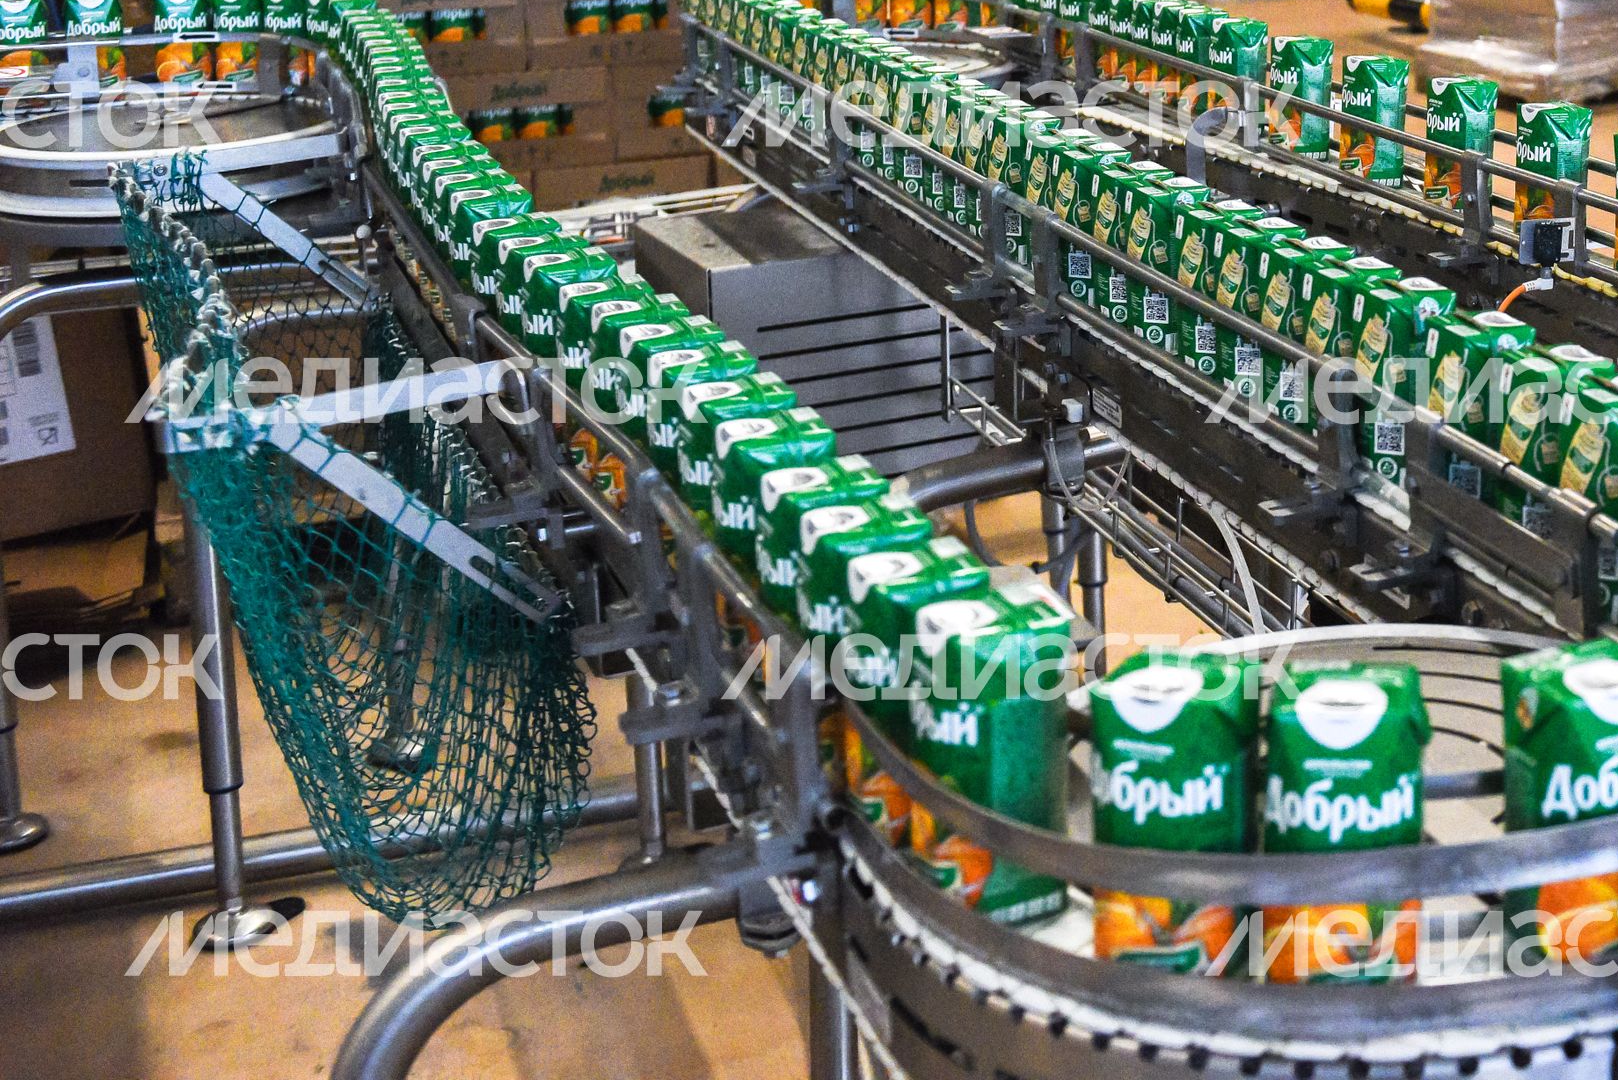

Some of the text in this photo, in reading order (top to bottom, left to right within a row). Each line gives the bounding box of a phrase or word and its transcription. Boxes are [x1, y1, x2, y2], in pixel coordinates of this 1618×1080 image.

[0, 21, 46, 43] обрый
[66, 16, 122, 37] Добрый
[154, 11, 207, 33] Добрый
[264, 12, 302, 32] брый
[1270, 61, 1298, 86] брый
[1341, 81, 1372, 108] брый
[1426, 107, 1461, 133] брый
[1516, 135, 1551, 163] брый
